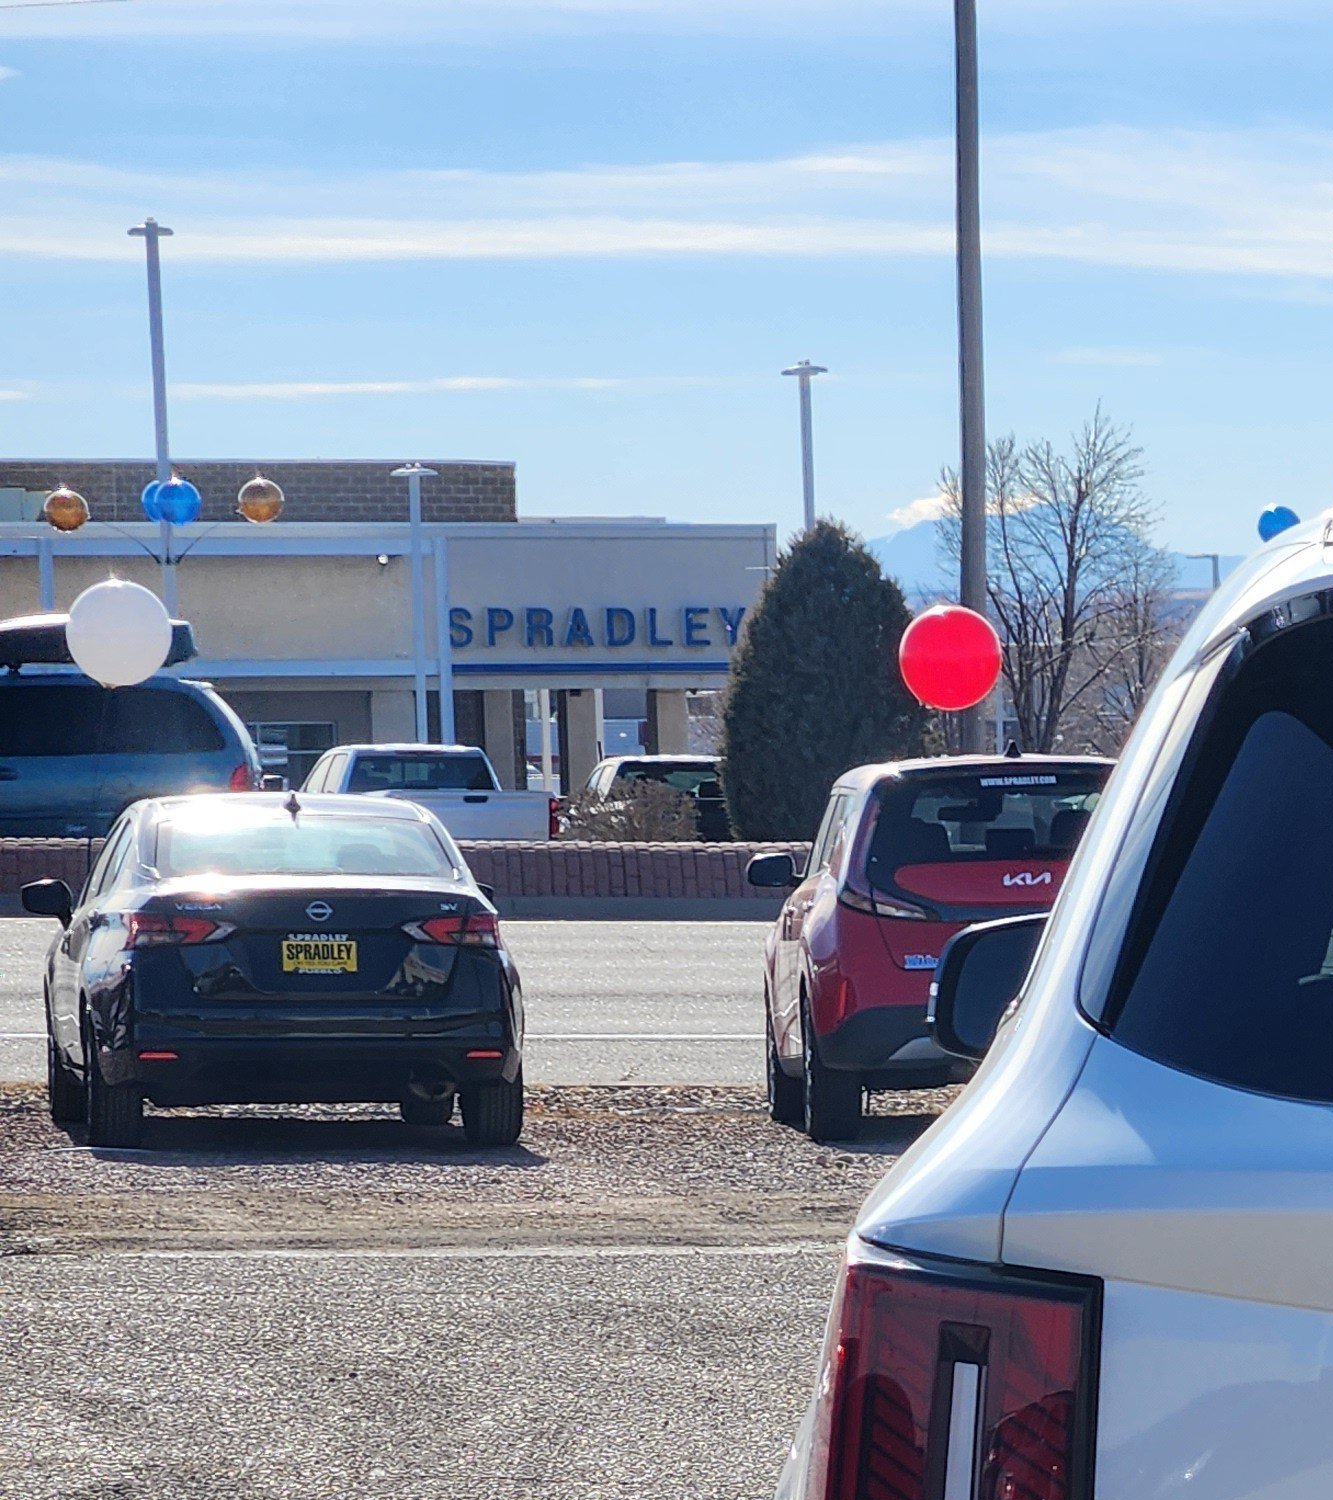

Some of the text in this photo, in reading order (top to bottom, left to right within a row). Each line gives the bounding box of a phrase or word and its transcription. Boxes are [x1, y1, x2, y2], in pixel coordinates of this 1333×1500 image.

[448, 606, 747, 648] SPRADLEY
[1002, 872, 1052, 886] KIA
[286, 943, 354, 960] SPRADLEY
